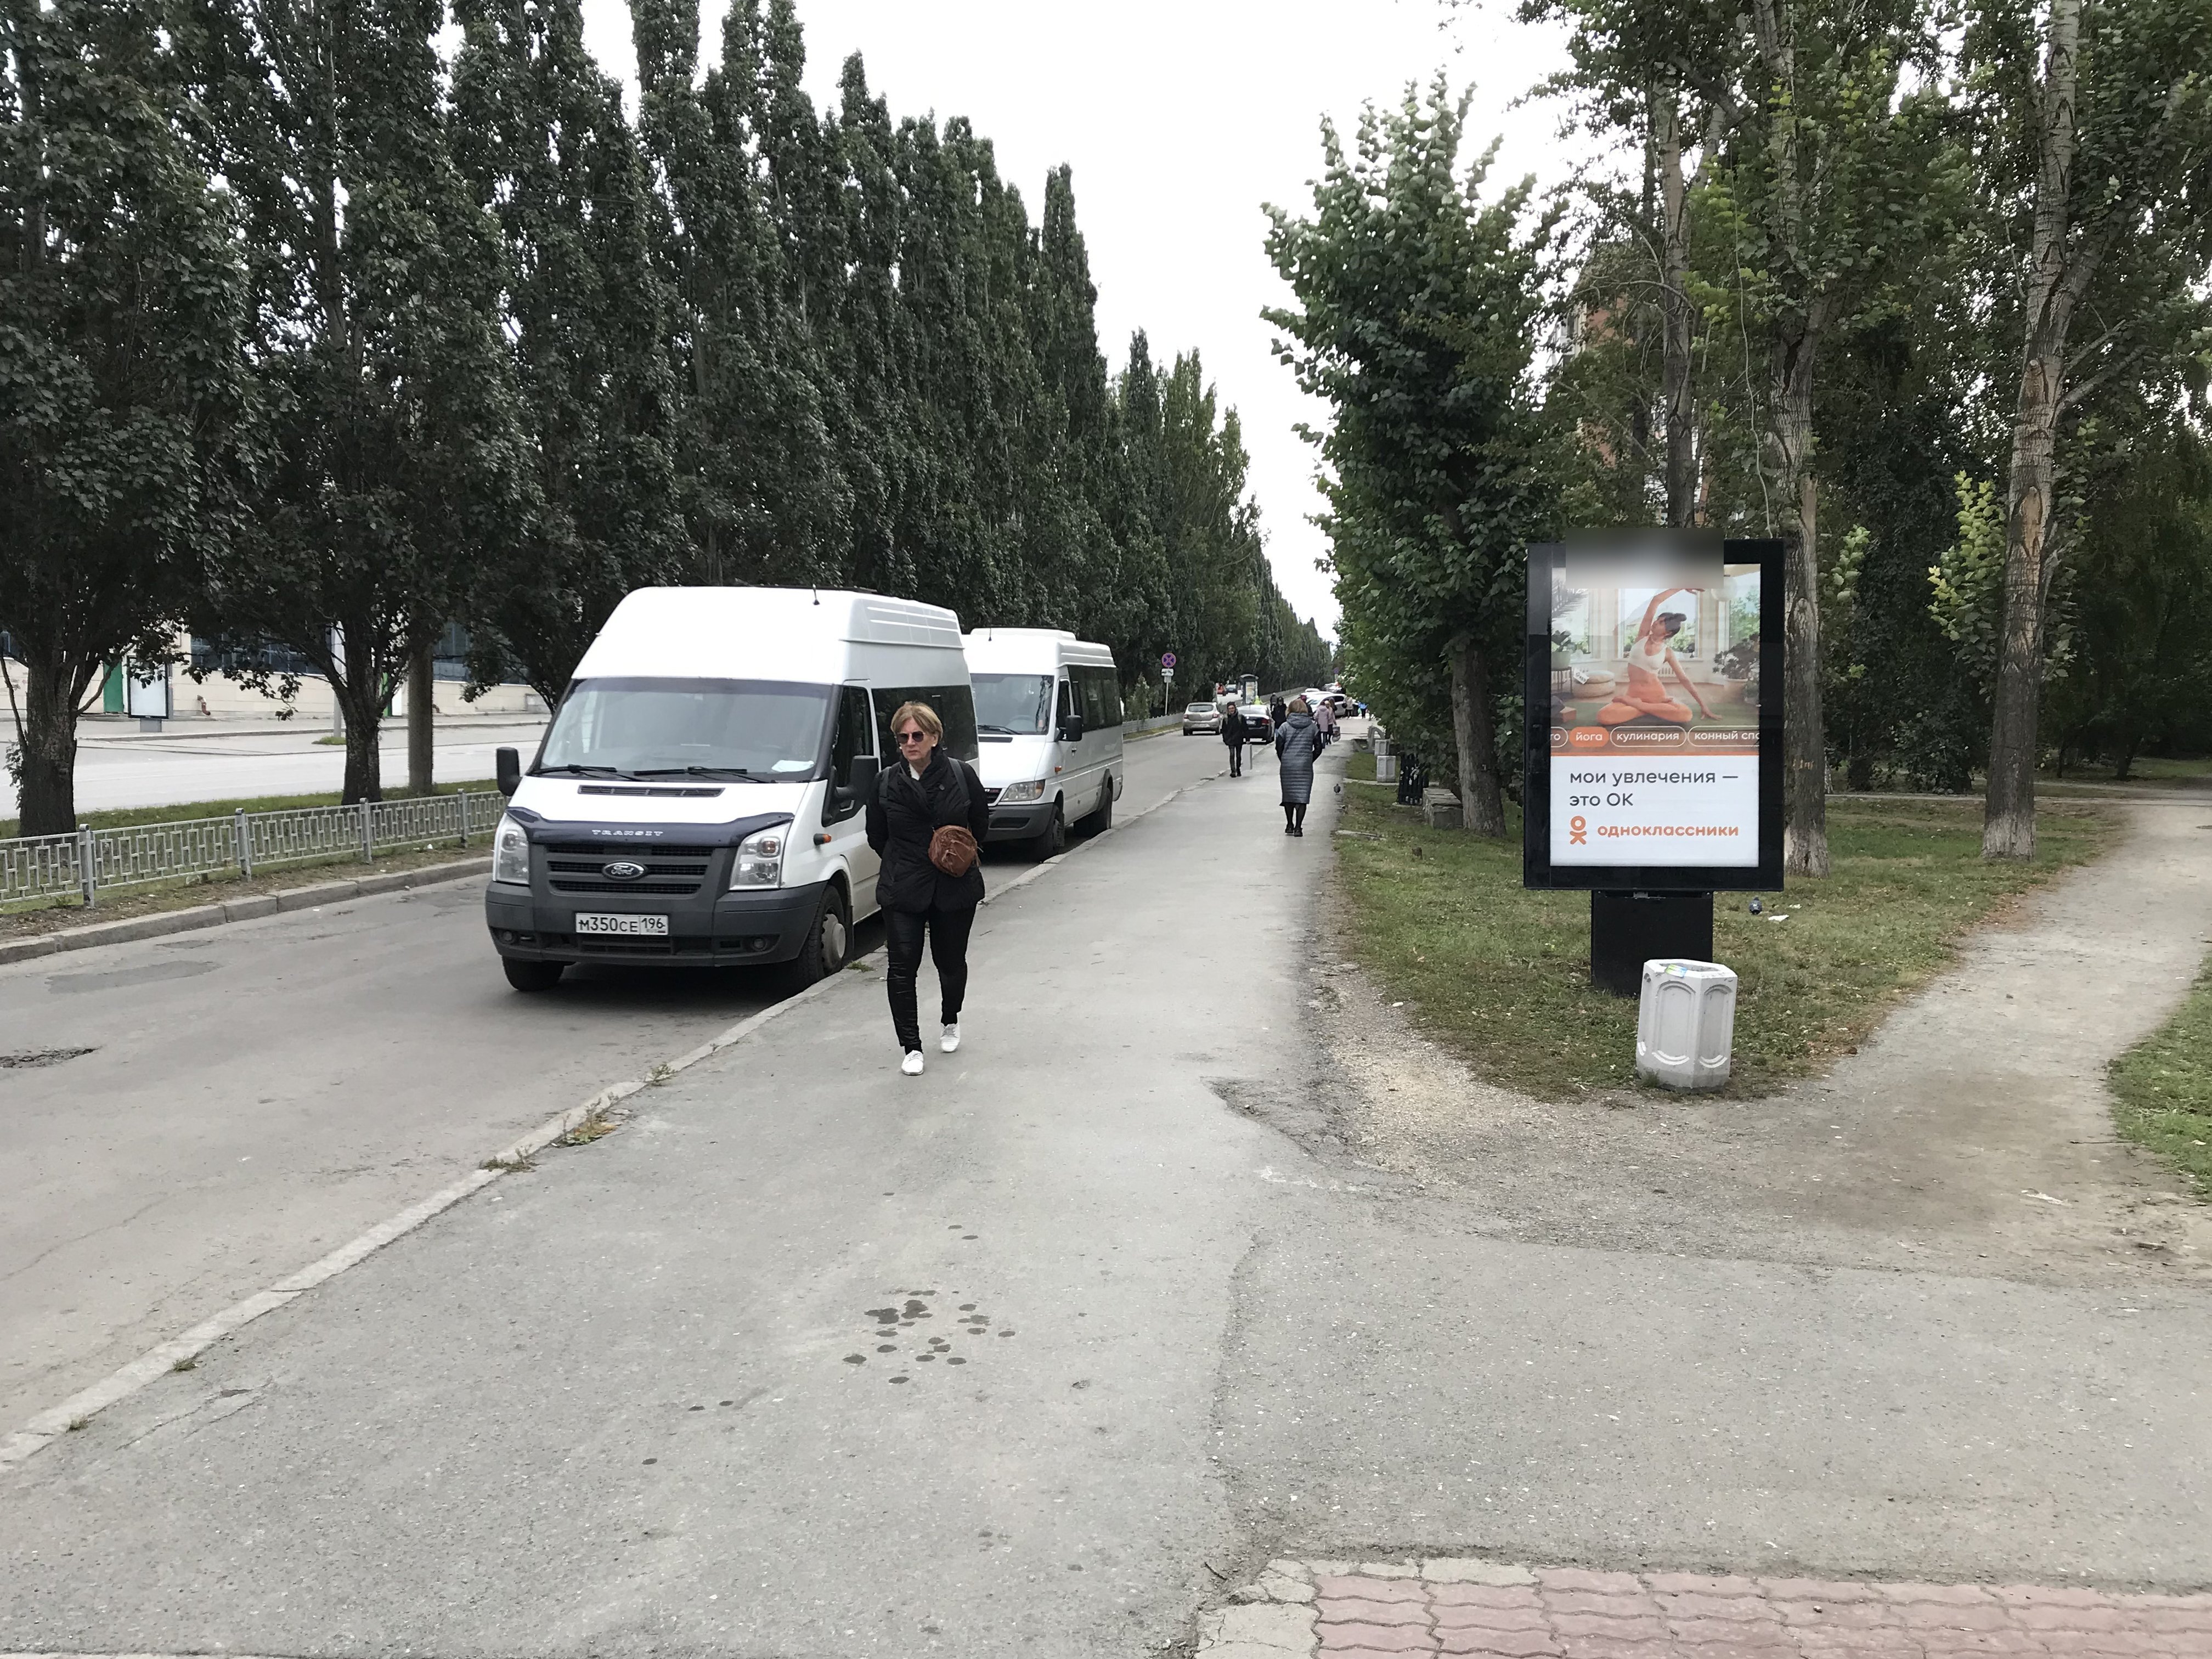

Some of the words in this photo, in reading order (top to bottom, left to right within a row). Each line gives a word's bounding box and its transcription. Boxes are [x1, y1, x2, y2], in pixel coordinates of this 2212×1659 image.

[1576, 731, 1603, 741] йога
[1617, 732, 1680, 742] кулинария
[1694, 731, 1738, 740] конный
[1570, 772, 1606, 783] мои
[1612, 772, 1716, 787] увлечения
[1570, 795, 1600, 806] это
[1597, 826, 1739, 838] одноклассники
[611, 865, 634, 875] Ford
